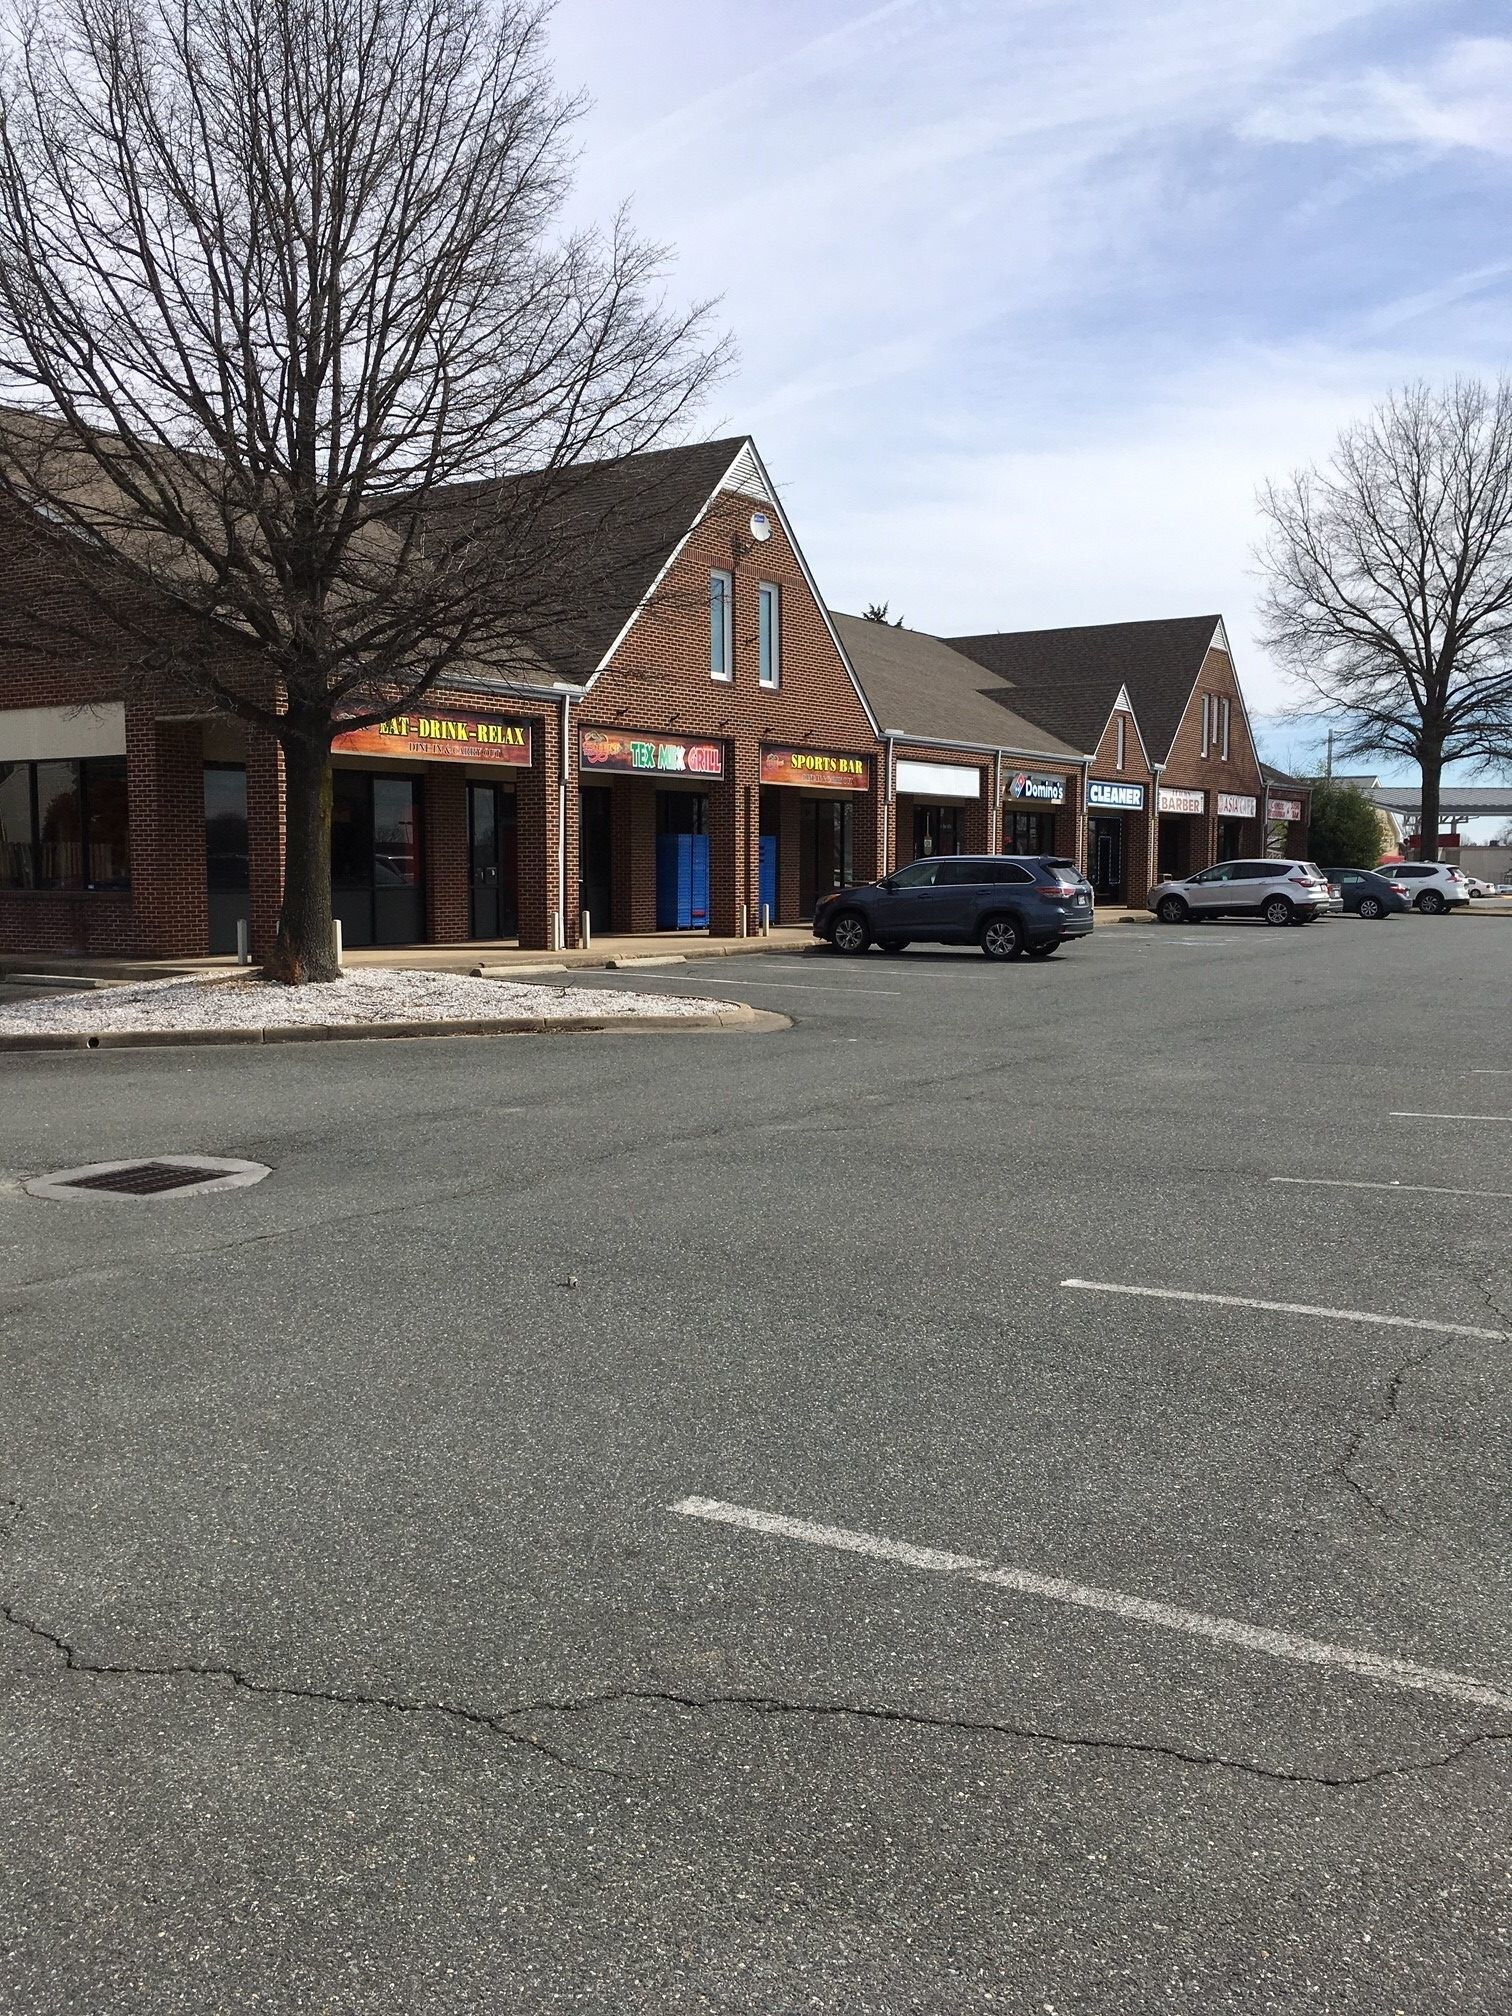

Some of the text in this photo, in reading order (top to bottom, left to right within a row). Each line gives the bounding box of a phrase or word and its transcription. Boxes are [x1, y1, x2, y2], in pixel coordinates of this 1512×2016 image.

[630, 741, 656, 768] TEX
[688, 746, 721, 774] GRILL
[791, 753, 863, 774] SPORTS BAR
[1025, 779, 1064, 799] Domino's
[1090, 785, 1141, 805] CLEANER
[1161, 797, 1200, 813] BARBER
